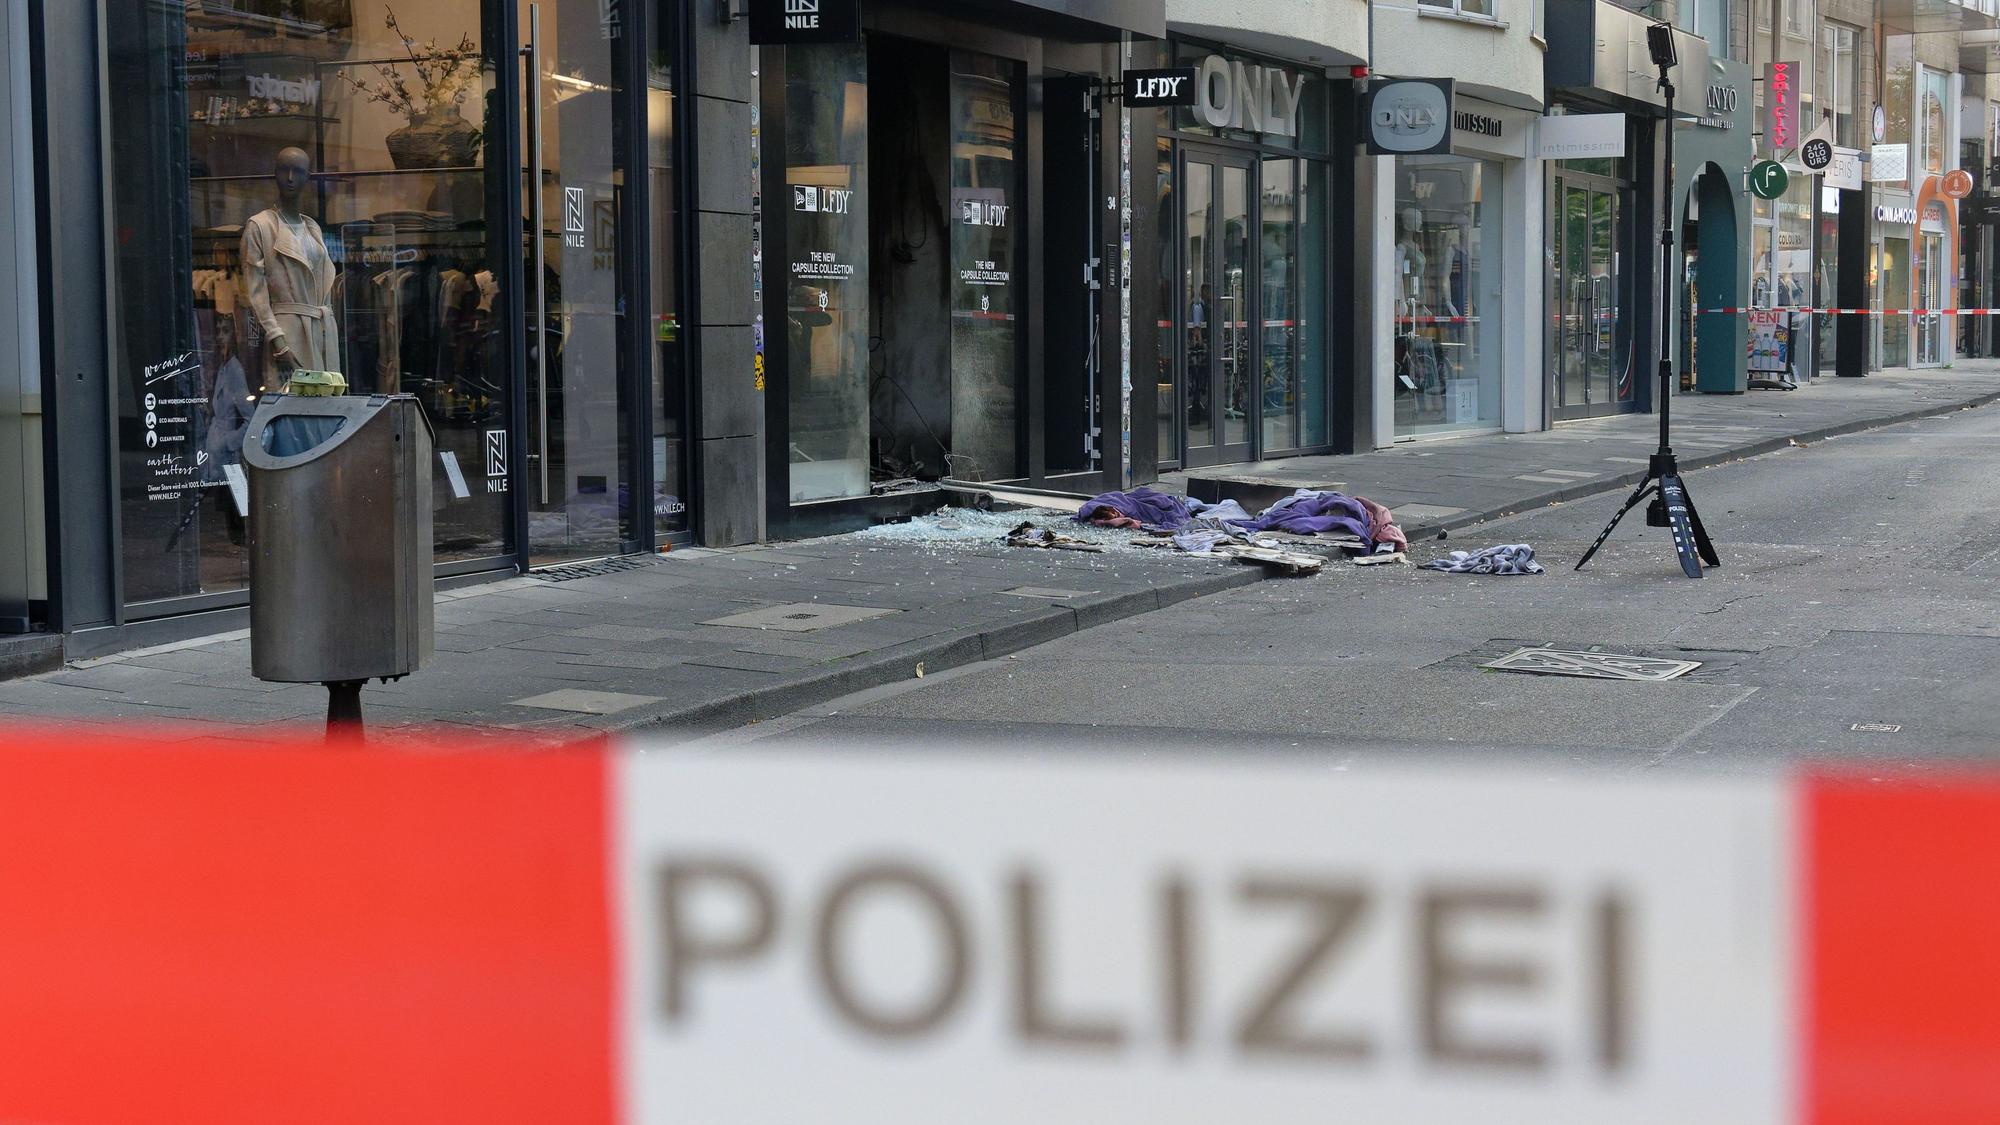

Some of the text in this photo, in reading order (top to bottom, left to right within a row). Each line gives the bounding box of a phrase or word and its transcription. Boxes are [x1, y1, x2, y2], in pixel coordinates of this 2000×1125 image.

[785, 15, 819, 29] NILE
[1194, 54, 1304, 137] ONLY
[1376, 104, 1440, 129] ONLY
[1543, 142, 1620, 153] intimissimi
[1807, 142, 1825, 153] 24C
[1807, 150, 1826, 159] OLO
[1809, 156, 1828, 166] URS
[1108, 196, 1116, 210] 34
[1877, 205, 1917, 224] CINNAMOOD
[566, 235, 584, 247] NILE
[810, 251, 835, 262] THE NEW
[792, 262, 853, 274] CAPSULE COLLECTION
[975, 260, 995, 270] THE NEW
[960, 270, 1010, 281] CAPSULE COLLECTION
[162, 351, 192, 370] care
[147, 453, 183, 466] earth
[155, 464, 199, 476] matters
[161, 483, 172, 491] Store
[189, 480, 200, 488] 100%
[487, 479, 507, 492] NILE
[649, 843, 1638, 1080] POLIZEI
